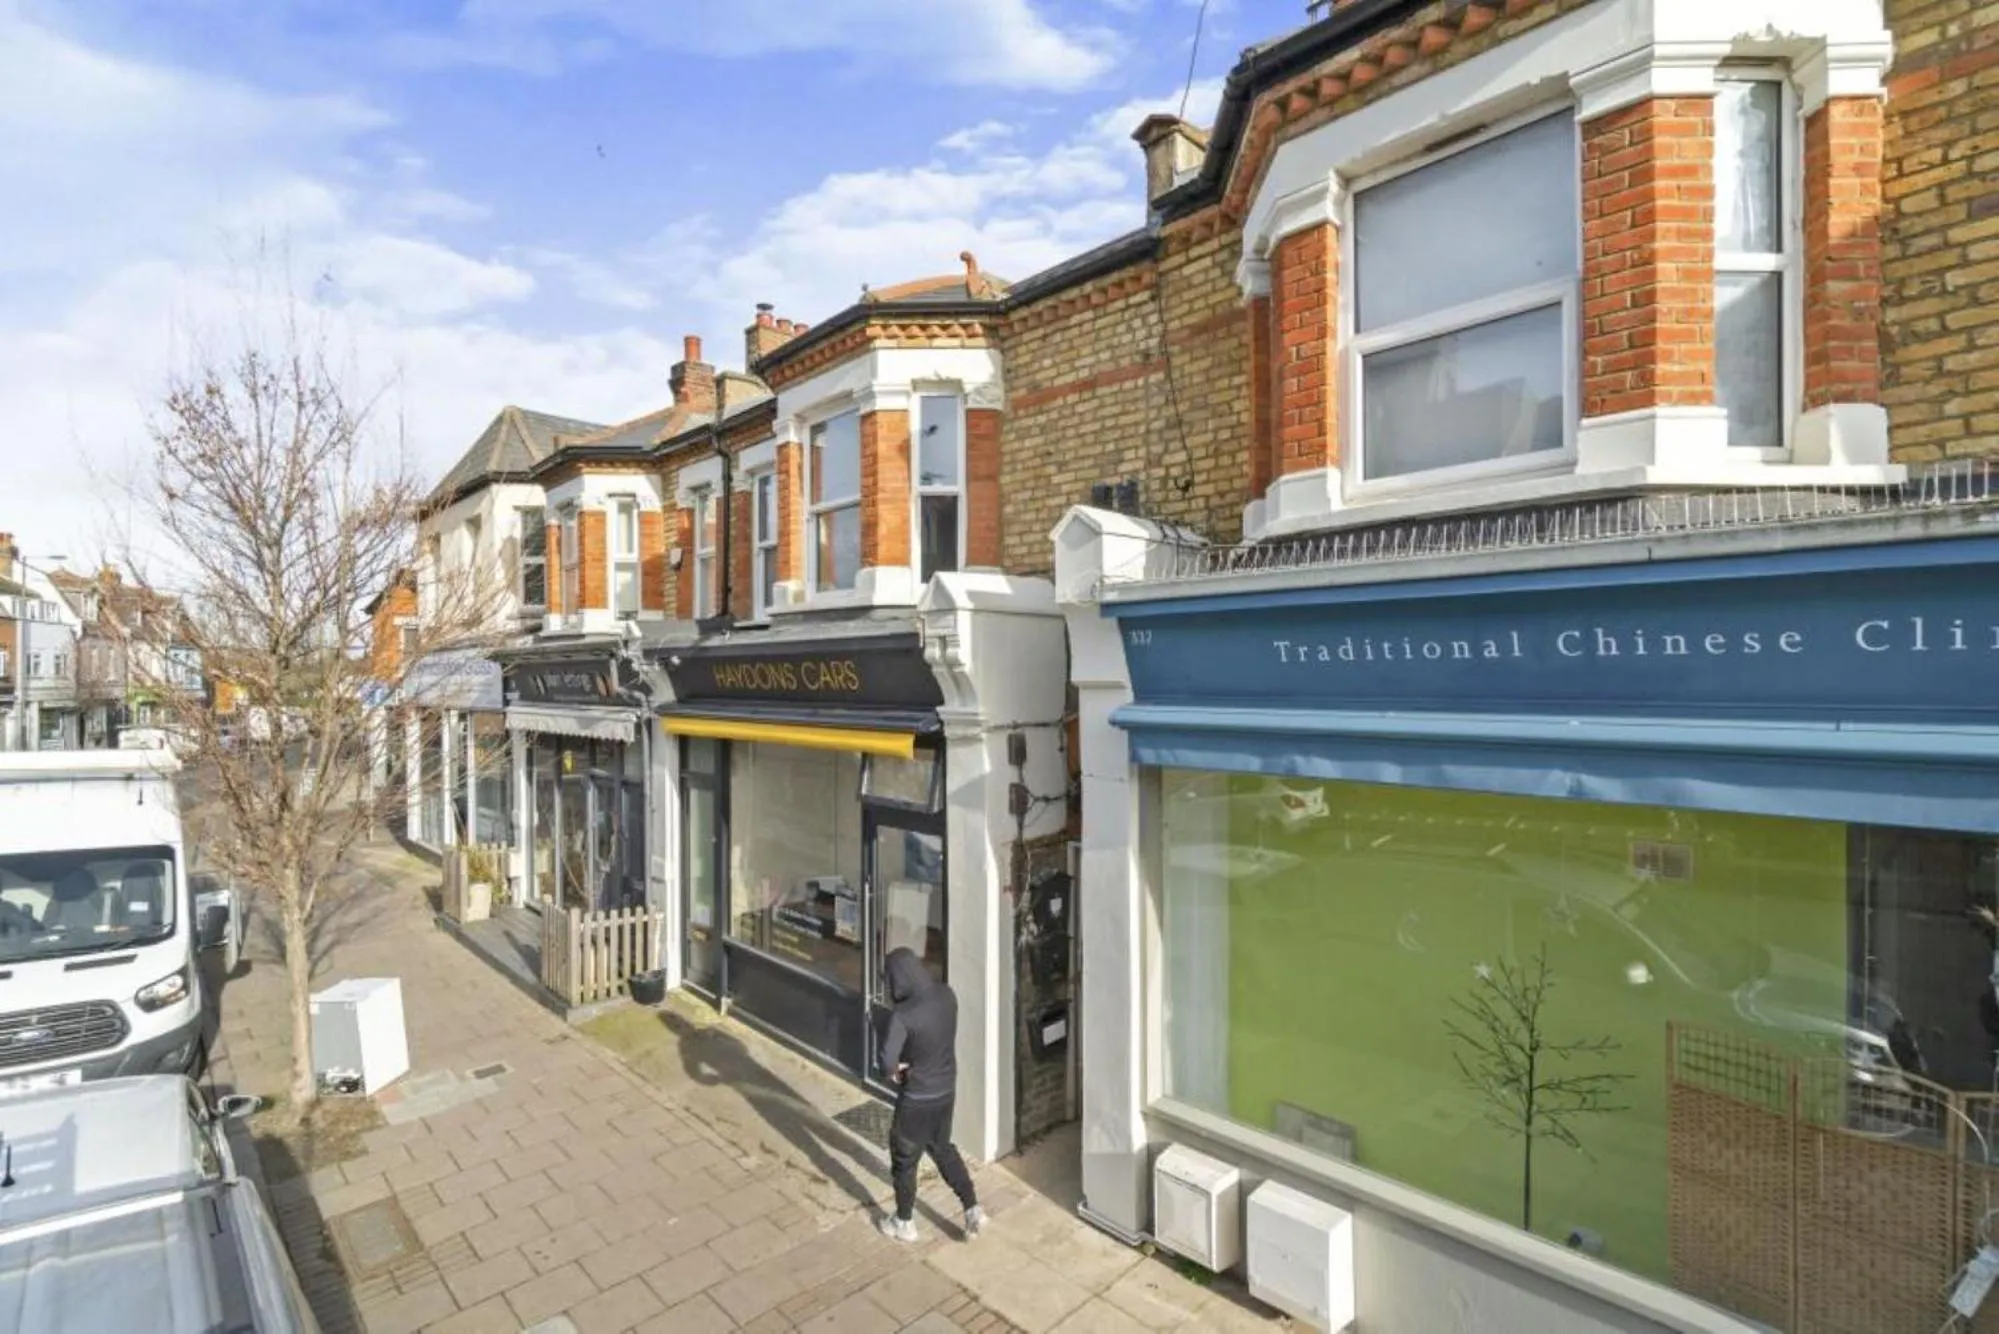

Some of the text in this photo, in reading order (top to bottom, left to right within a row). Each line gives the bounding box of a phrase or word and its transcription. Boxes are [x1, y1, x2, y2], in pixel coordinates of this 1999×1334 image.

[1273, 630, 1524, 662] Traditional
[1556, 628, 1804, 656] Chinese
[712, 660, 860, 691] HAYDONS CARS
